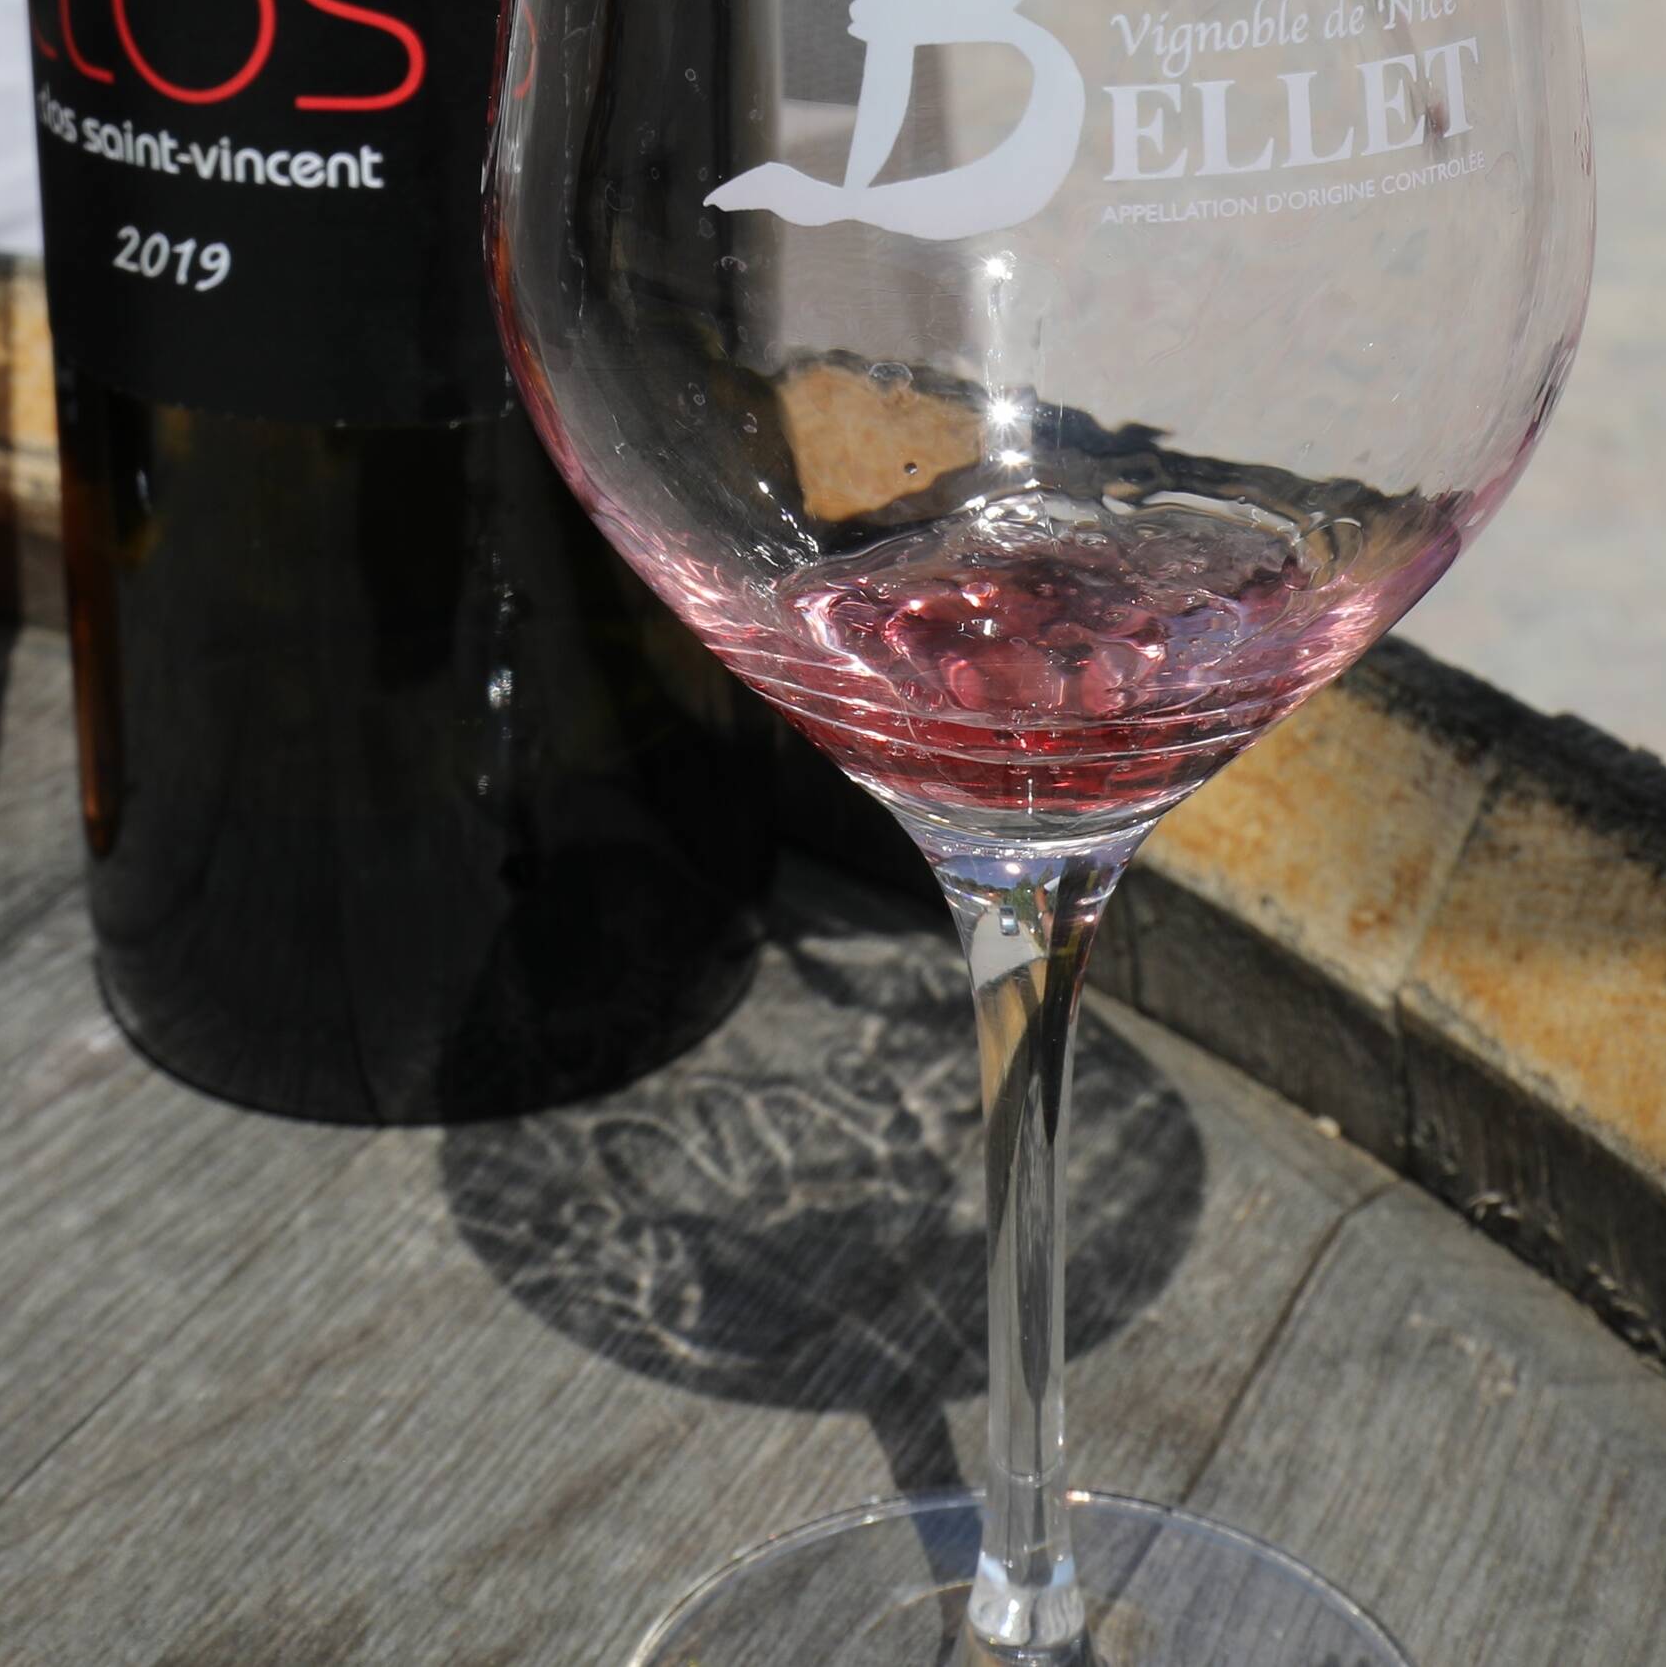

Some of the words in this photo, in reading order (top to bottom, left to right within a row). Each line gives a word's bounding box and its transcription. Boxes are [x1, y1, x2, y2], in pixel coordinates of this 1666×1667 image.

[81, 115, 386, 191] saint-vincent
[1099, 194, 1260, 225] APPELLATION
[1265, 178, 1376, 215] D'ORIGINE
[112, 223, 234, 293] 2019
